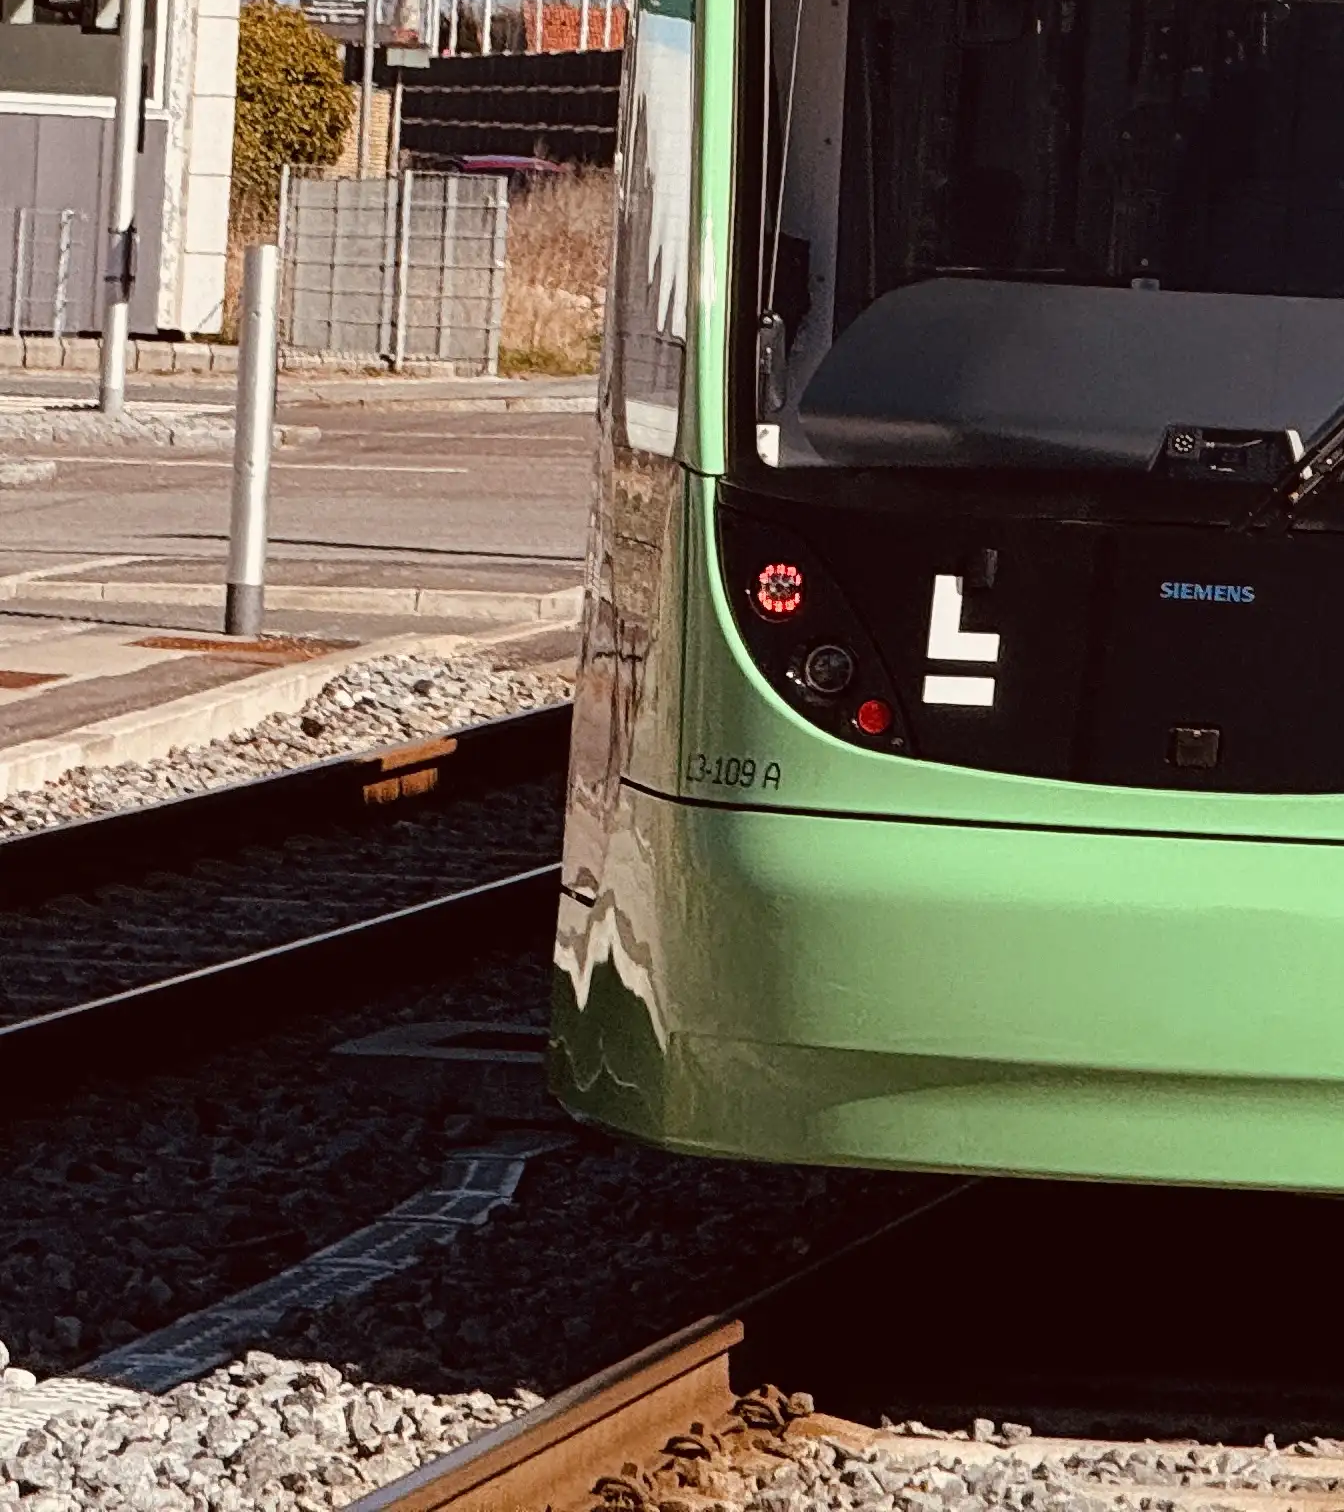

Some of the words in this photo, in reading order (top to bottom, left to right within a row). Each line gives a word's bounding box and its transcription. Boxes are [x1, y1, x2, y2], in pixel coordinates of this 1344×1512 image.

[1159, 581, 1256, 604] SIEMENS
[685, 752, 757, 788] L3-109
[761, 761, 782, 791] A
